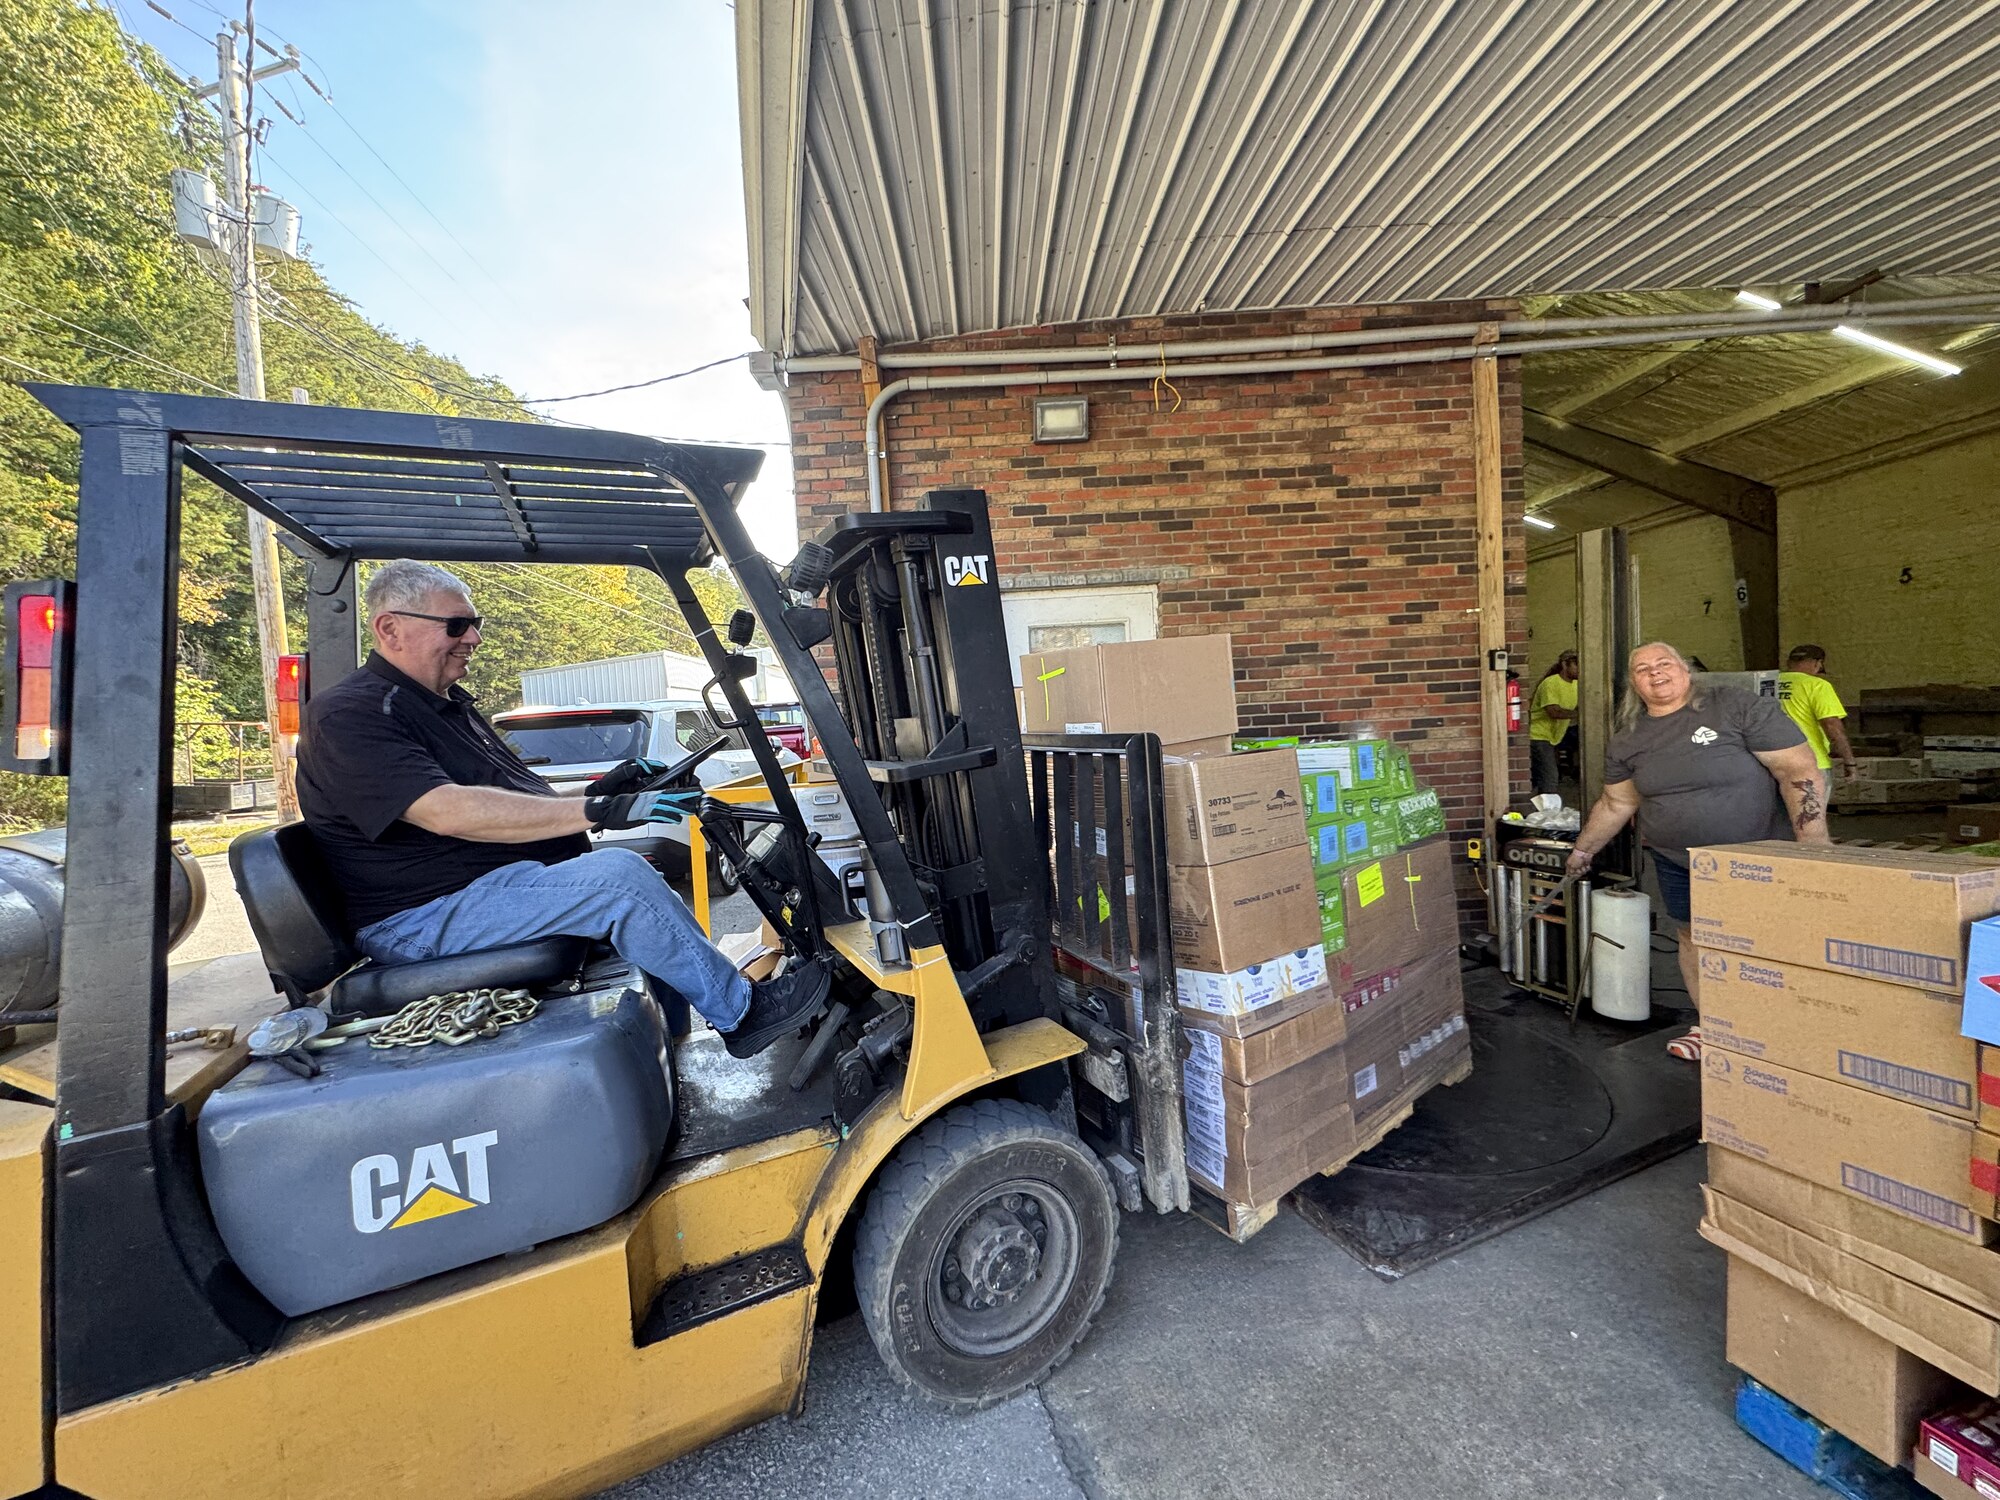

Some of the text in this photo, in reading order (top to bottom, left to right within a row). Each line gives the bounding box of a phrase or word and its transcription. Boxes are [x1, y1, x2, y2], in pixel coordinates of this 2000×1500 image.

[944, 555, 989, 587] CAT
[1899, 567, 1912, 584] 5
[1737, 586, 1746, 601] 6
[1703, 601, 1712, 615] 7
[1208, 796, 1232, 807] 30733
[1266, 799, 1298, 811] Sunny Fresh
[1508, 848, 1561, 867] orion
[1729, 860, 1773, 874] Banana
[1729, 870, 1774, 883] Cookies
[1739, 962, 1783, 979] Banana
[1739, 972, 1784, 989] Cookies
[1743, 1065, 1787, 1086] Banana
[1743, 1075, 1788, 1095] Cookies
[350, 1129, 498, 1234] CAT
